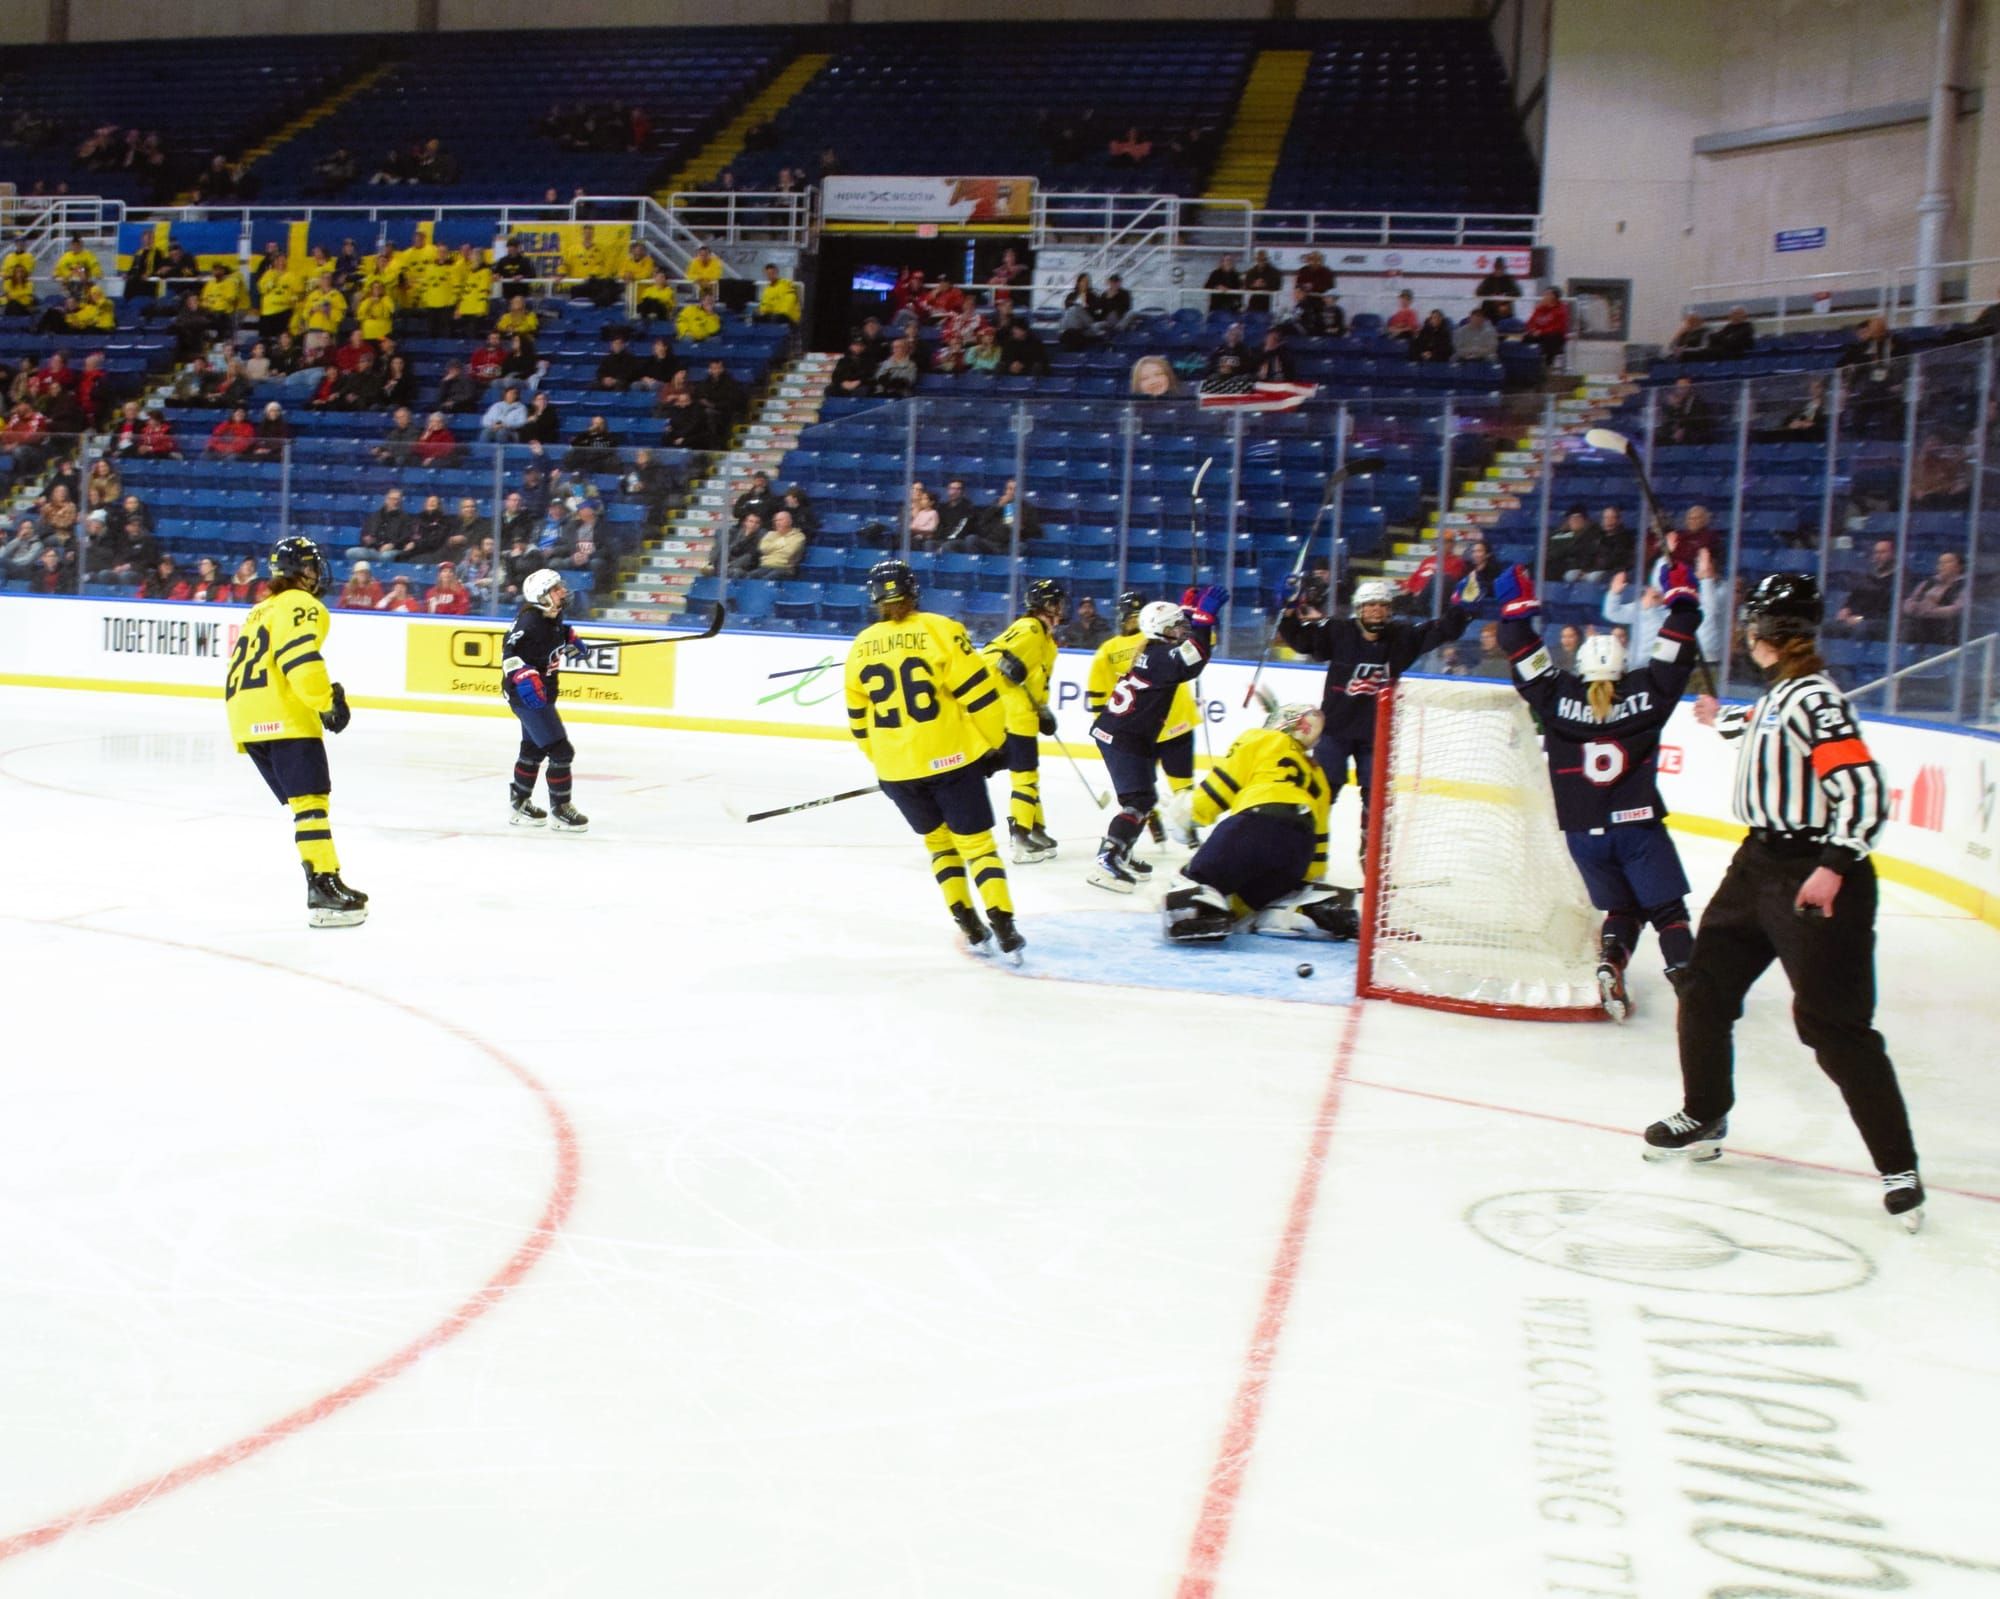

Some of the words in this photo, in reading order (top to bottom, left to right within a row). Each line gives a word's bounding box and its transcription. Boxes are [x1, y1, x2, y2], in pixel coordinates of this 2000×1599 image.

[103, 616, 191, 656] TOGETHER
[194, 621, 222, 658] WE
[292, 606, 320, 627] 22
[226, 625, 269, 703] 22
[859, 656, 941, 728] 26
[558, 685, 582, 699] and
[587, 687, 623, 701] Tires.
[1632, 1303, 2000, 1599] Memb
